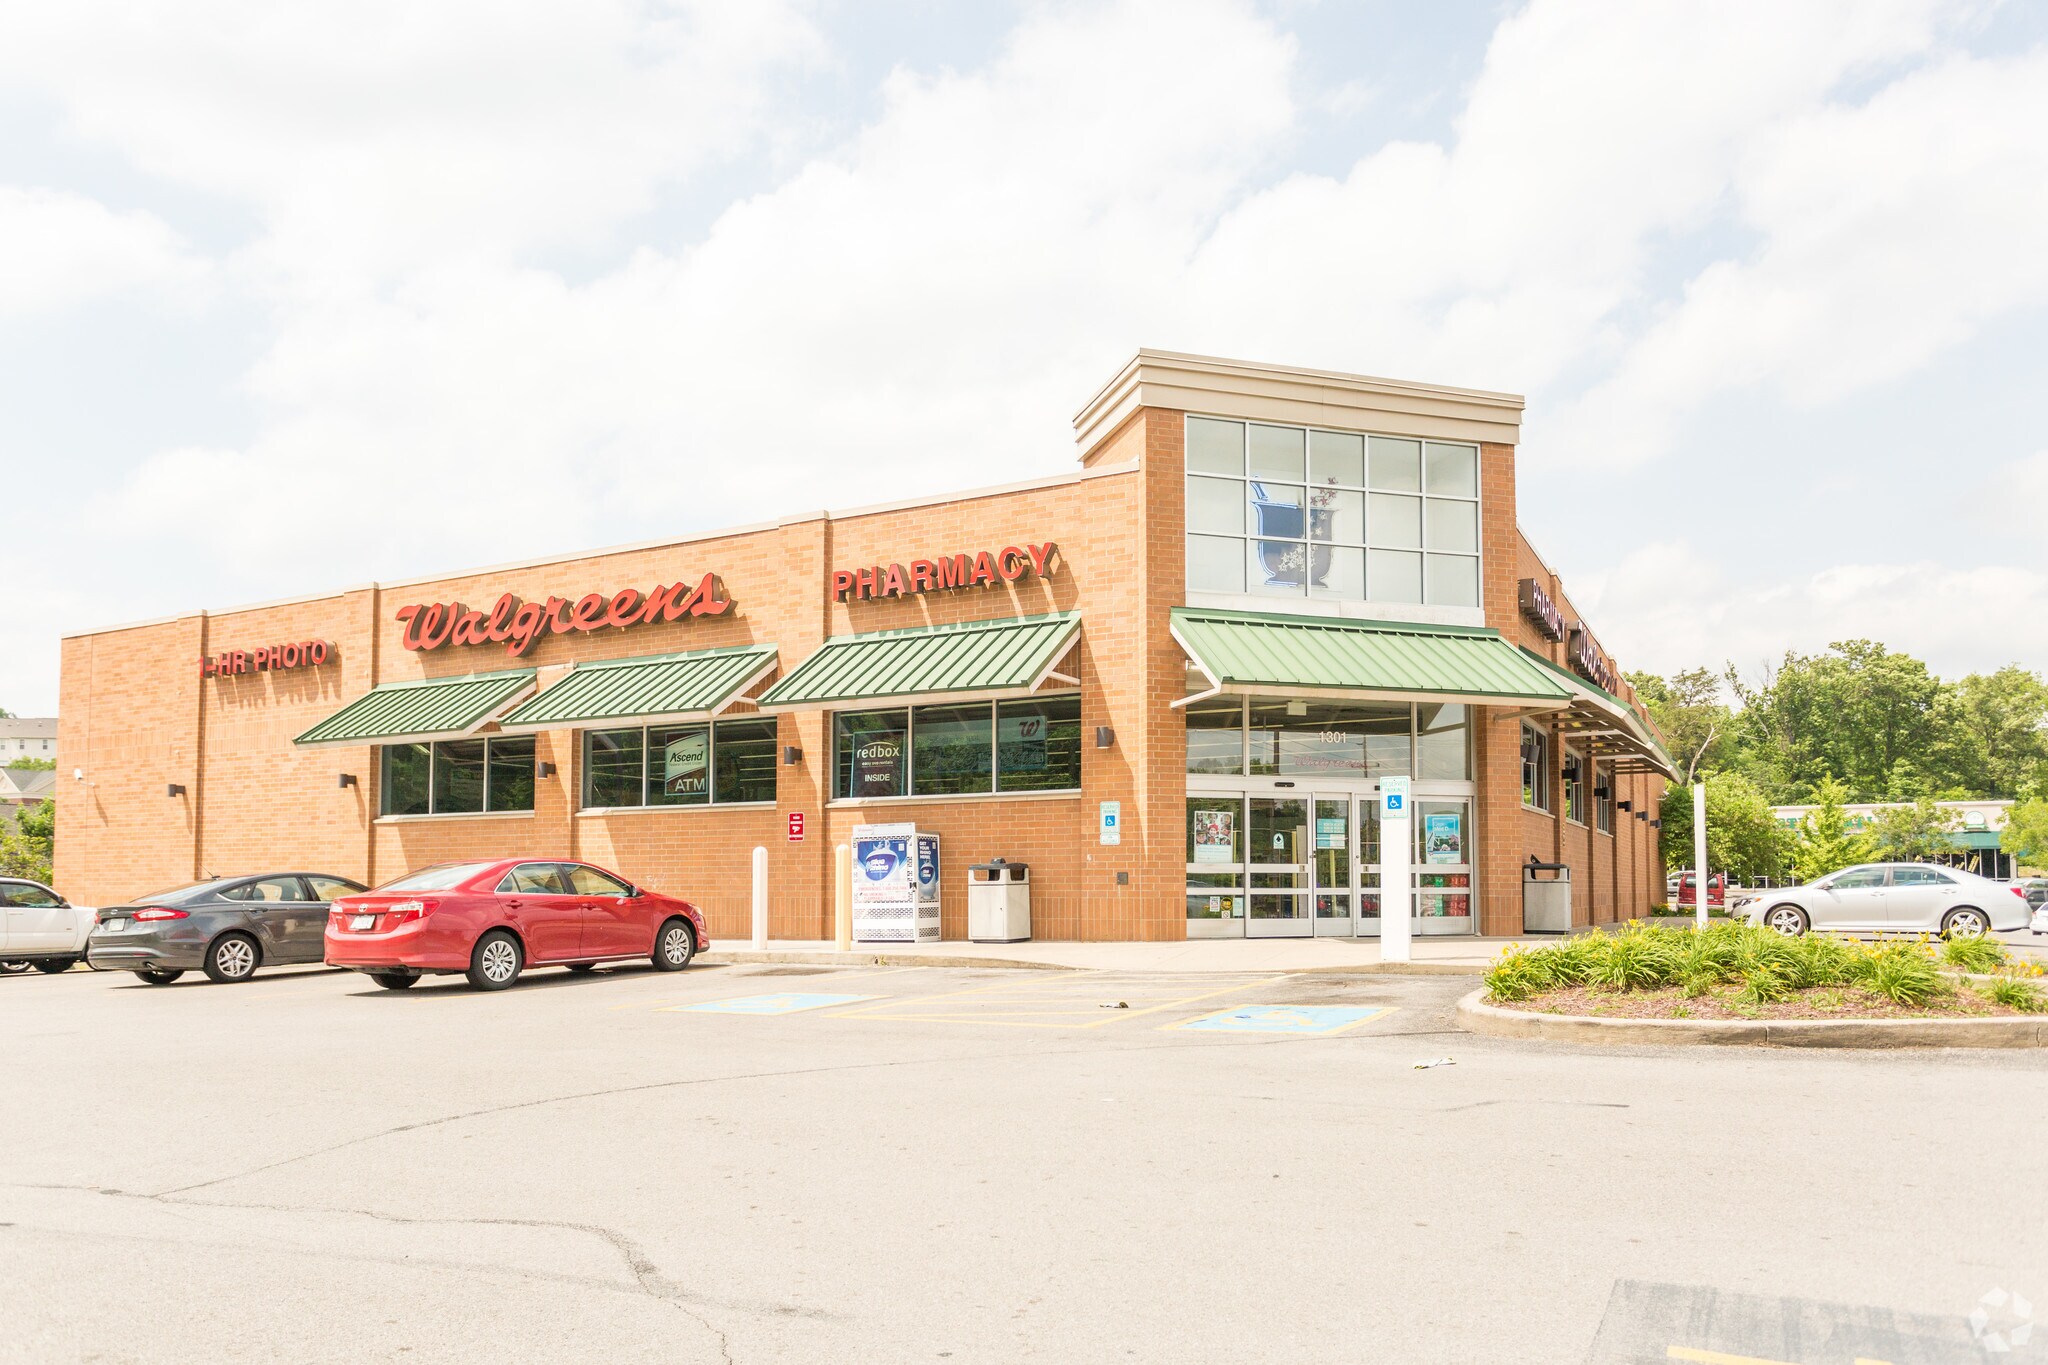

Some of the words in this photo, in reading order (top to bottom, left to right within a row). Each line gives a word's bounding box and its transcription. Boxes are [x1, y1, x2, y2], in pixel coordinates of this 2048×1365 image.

[832, 541, 1054, 600] PHARMACY
[395, 572, 730, 658] Walgreens
[198, 649, 246, 678] 1-HR
[253, 639, 327, 672] PHOTO
[1318, 731, 1347, 744] 1301
[669, 751, 703, 762] Ascend
[857, 745, 899, 758] redbox
[675, 778, 705, 791] ATM
[864, 774, 890, 782] INSIDE
